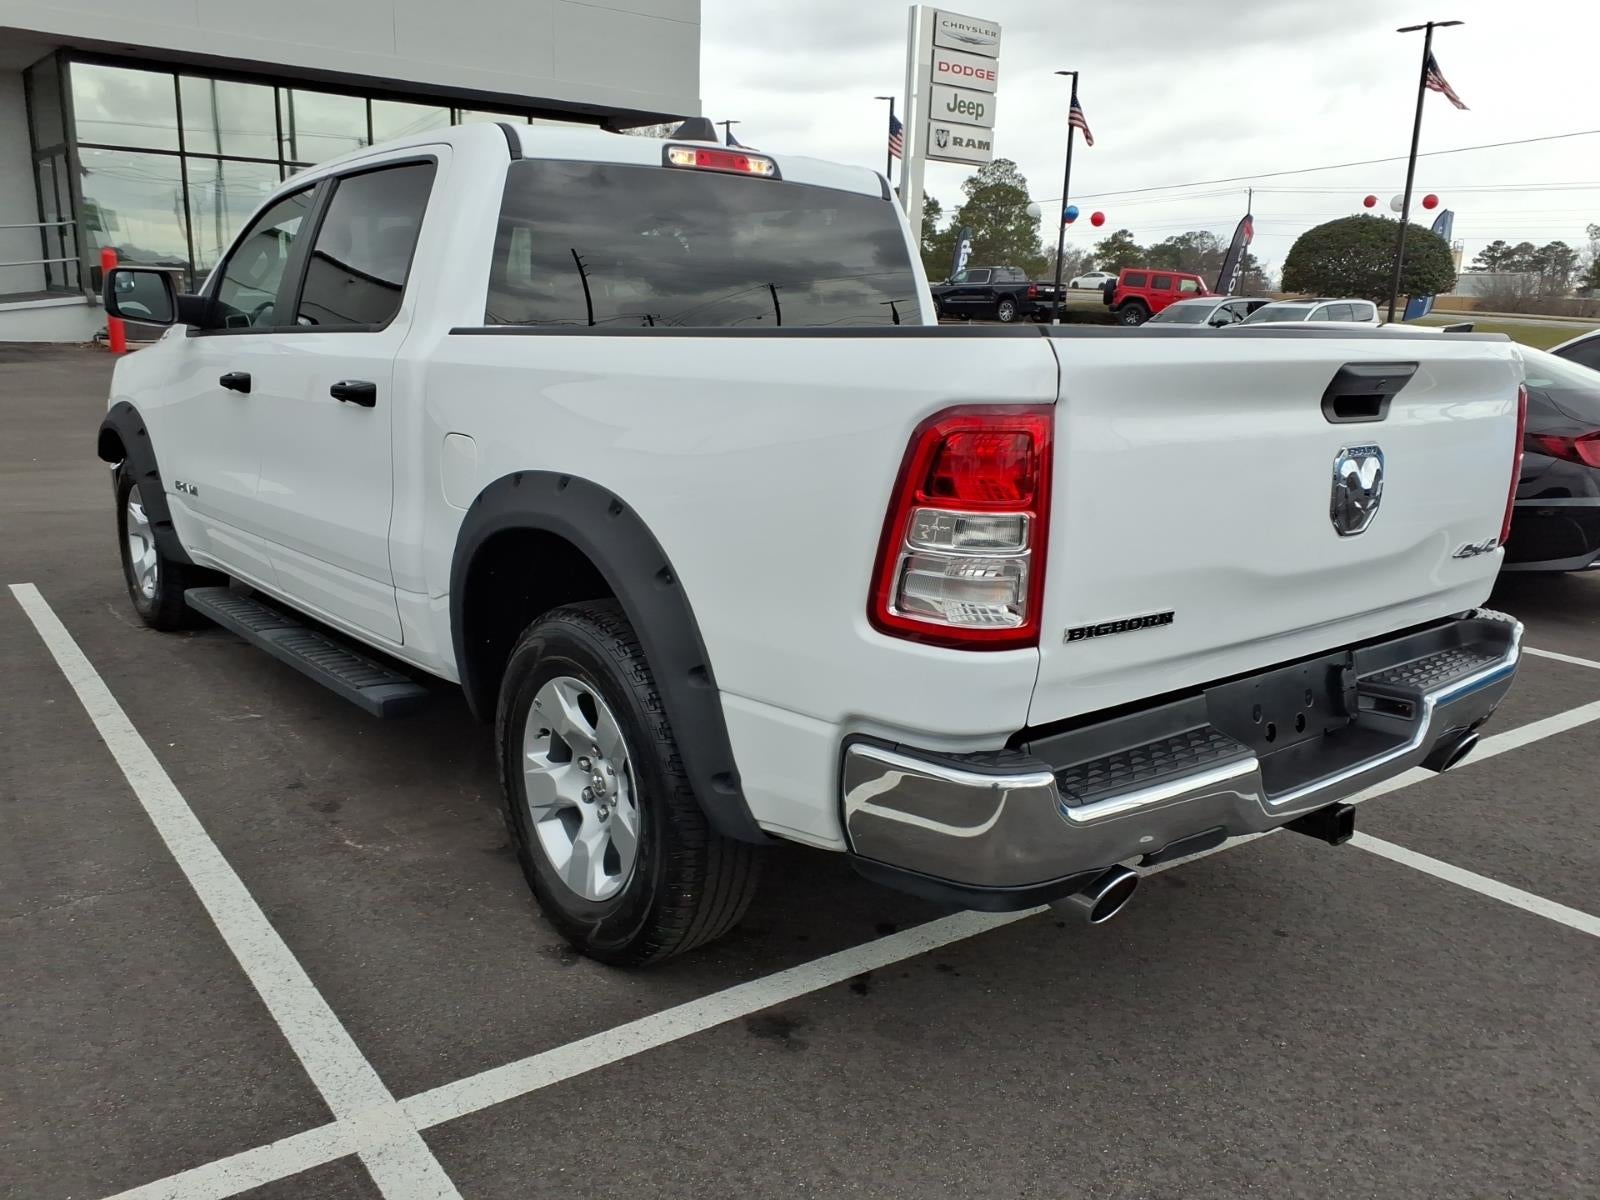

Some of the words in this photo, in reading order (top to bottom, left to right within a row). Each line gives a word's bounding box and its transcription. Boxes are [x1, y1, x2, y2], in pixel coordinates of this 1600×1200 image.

[942, 20, 997, 38] CHRYSLER
[938, 61, 995, 81] DODGE
[946, 93, 985, 120] Jeep
[952, 136, 991, 151] RAM
